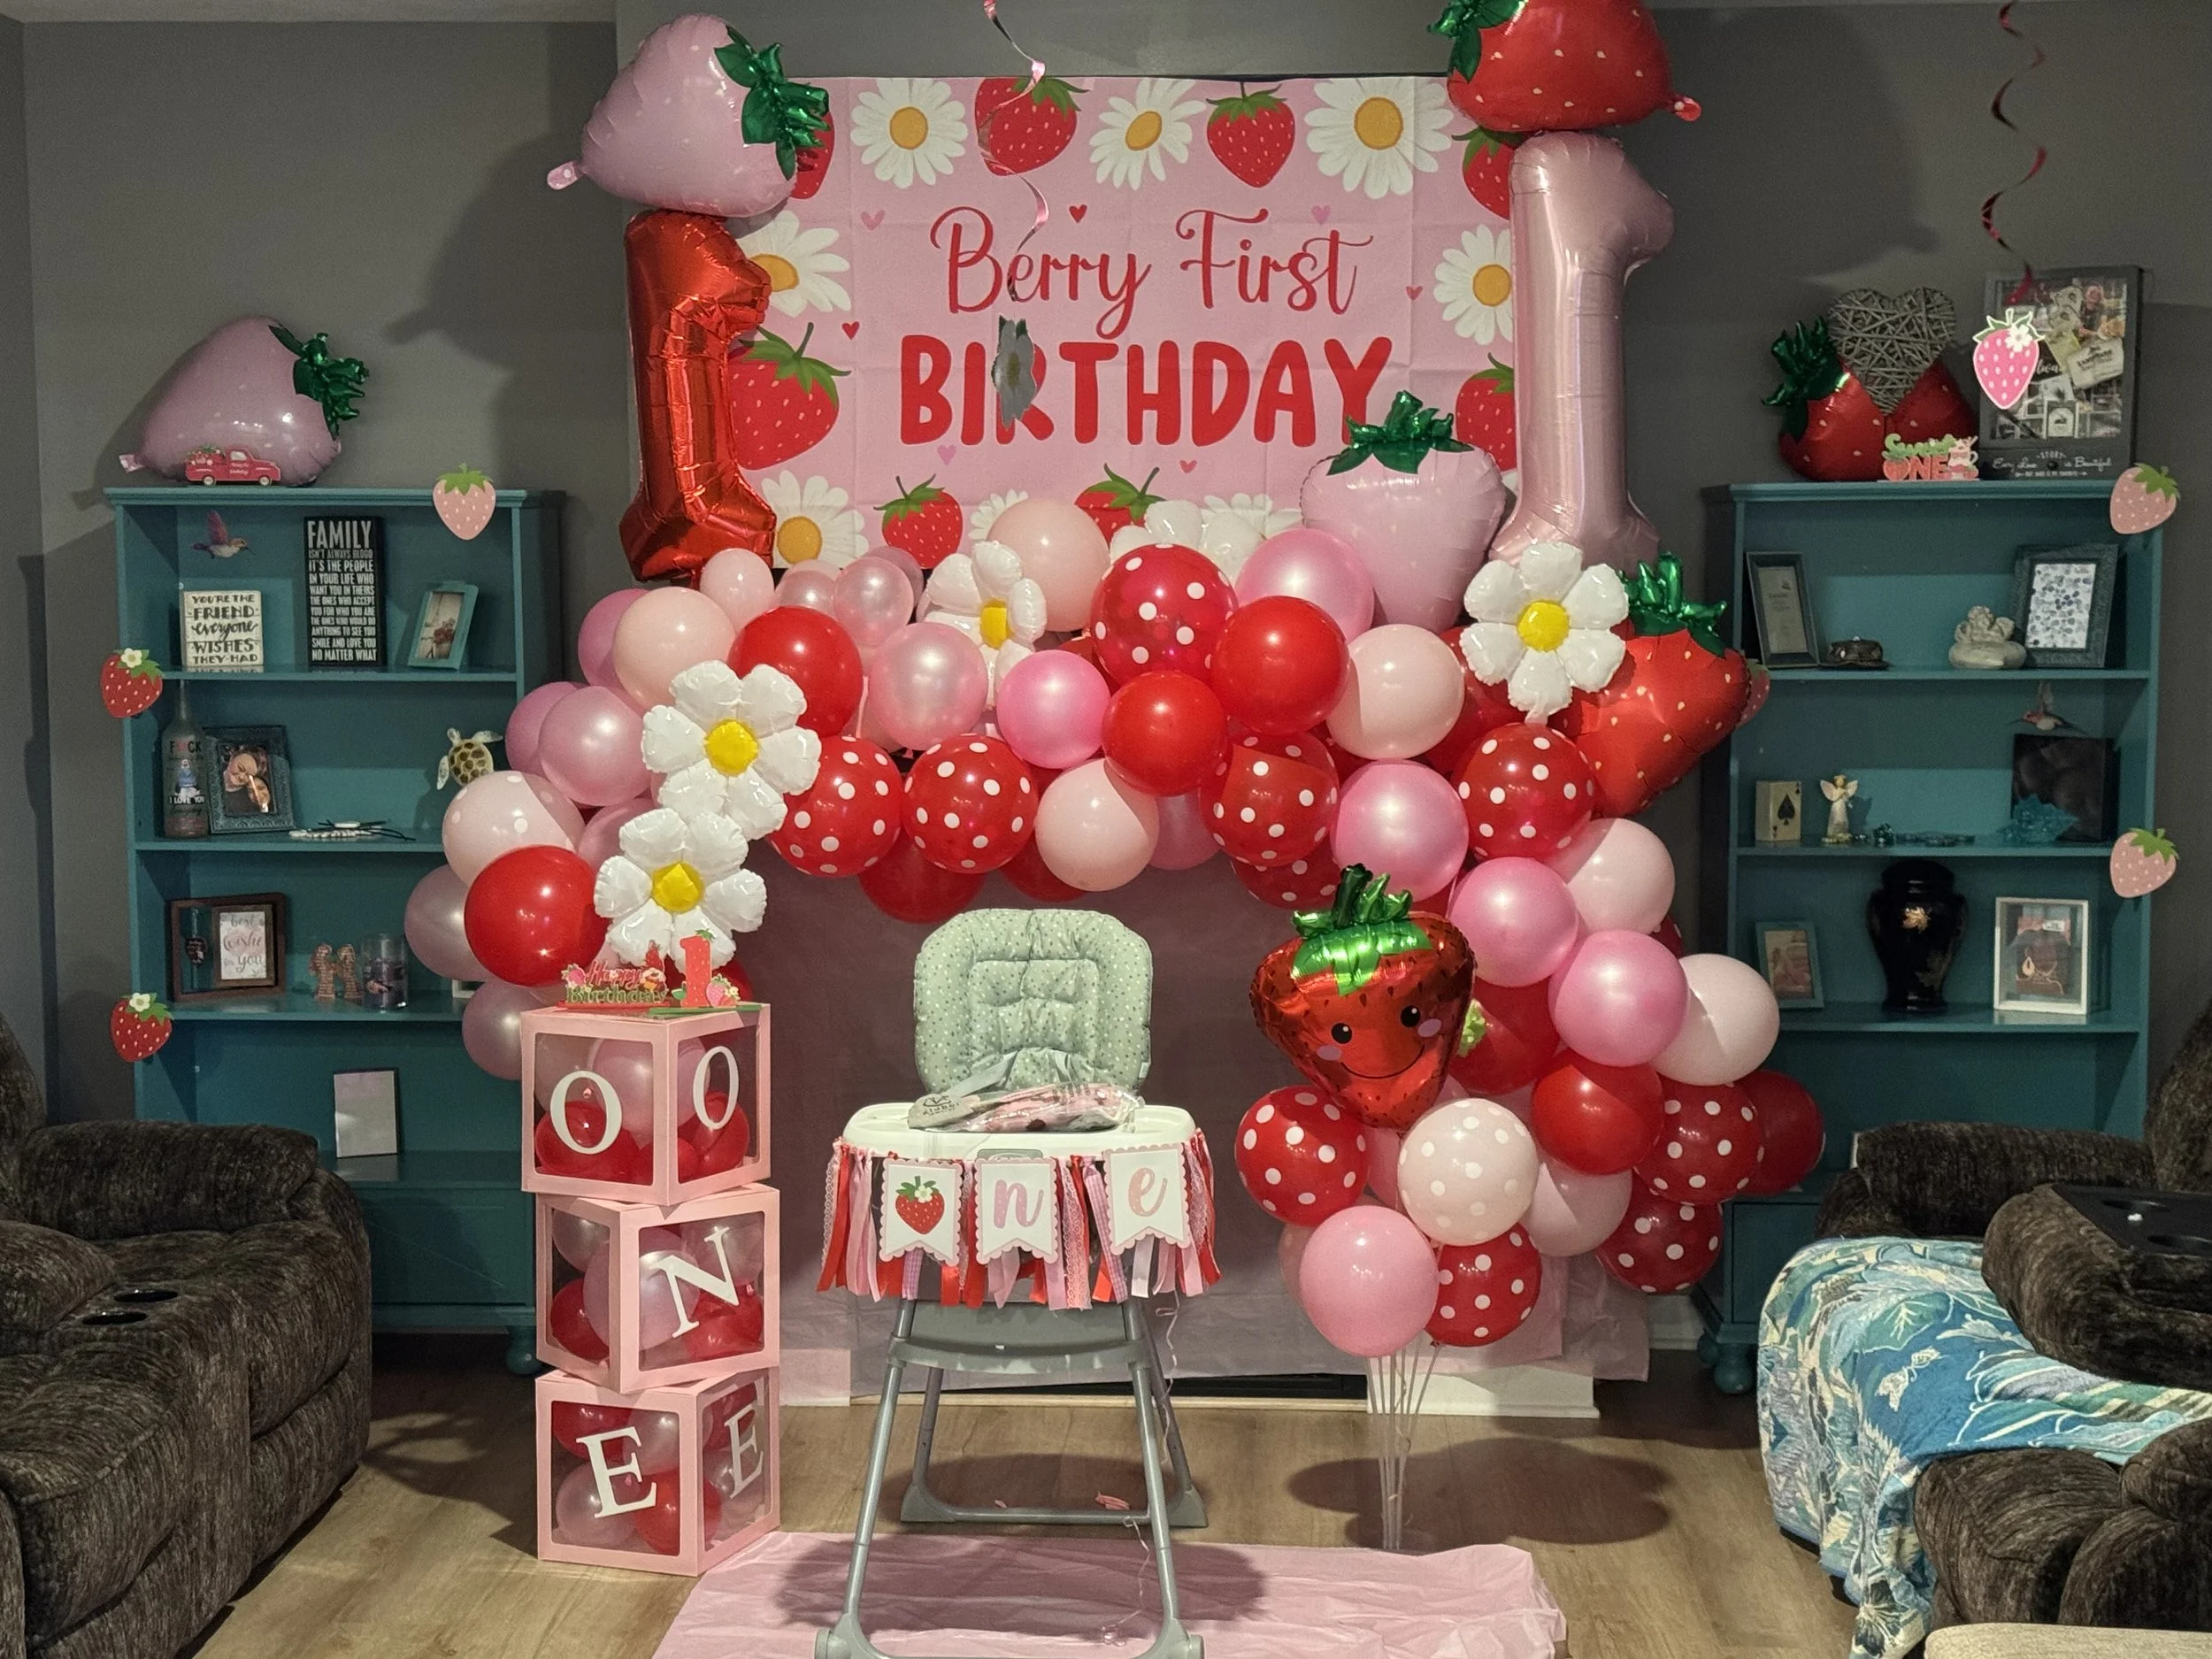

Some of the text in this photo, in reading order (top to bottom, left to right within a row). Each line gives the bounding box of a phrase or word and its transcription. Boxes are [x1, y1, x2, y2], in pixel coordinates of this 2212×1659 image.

[930, 205, 1373, 340] Berry First
[901, 334, 1393, 448] BIRTHDAY
[307, 520, 372, 549] FAMILY
[309, 559, 374, 572] IT'S THE PEOPLE
[310, 573, 374, 585] IN YOUR LIFE WHO
[191, 594, 255, 604] YOU'RE THE
[310, 585, 375, 595] WANT YOU IN THEIRS
[193, 605, 255, 620] FRIEND
[190, 620, 259, 641] everyone
[192, 638, 254, 654] WISHES
[311, 637, 377, 649] SMILE AND LOVE YOU
[192, 654, 258, 664] THEY HAD
[311, 649, 377, 661] NO MATTER WHAT
[170, 741, 202, 753] FCK
[235, 955, 264, 973] you
[680, 934, 712, 1008] 1
[585, 959, 643, 990] Happy
[566, 985, 669, 1003] Birthday
[693, 1046, 740, 1130] O
[549, 1070, 623, 1155] O
[649, 1225, 740, 1339] N
[723, 1403, 765, 1500] E
[575, 1425, 657, 1519] E
